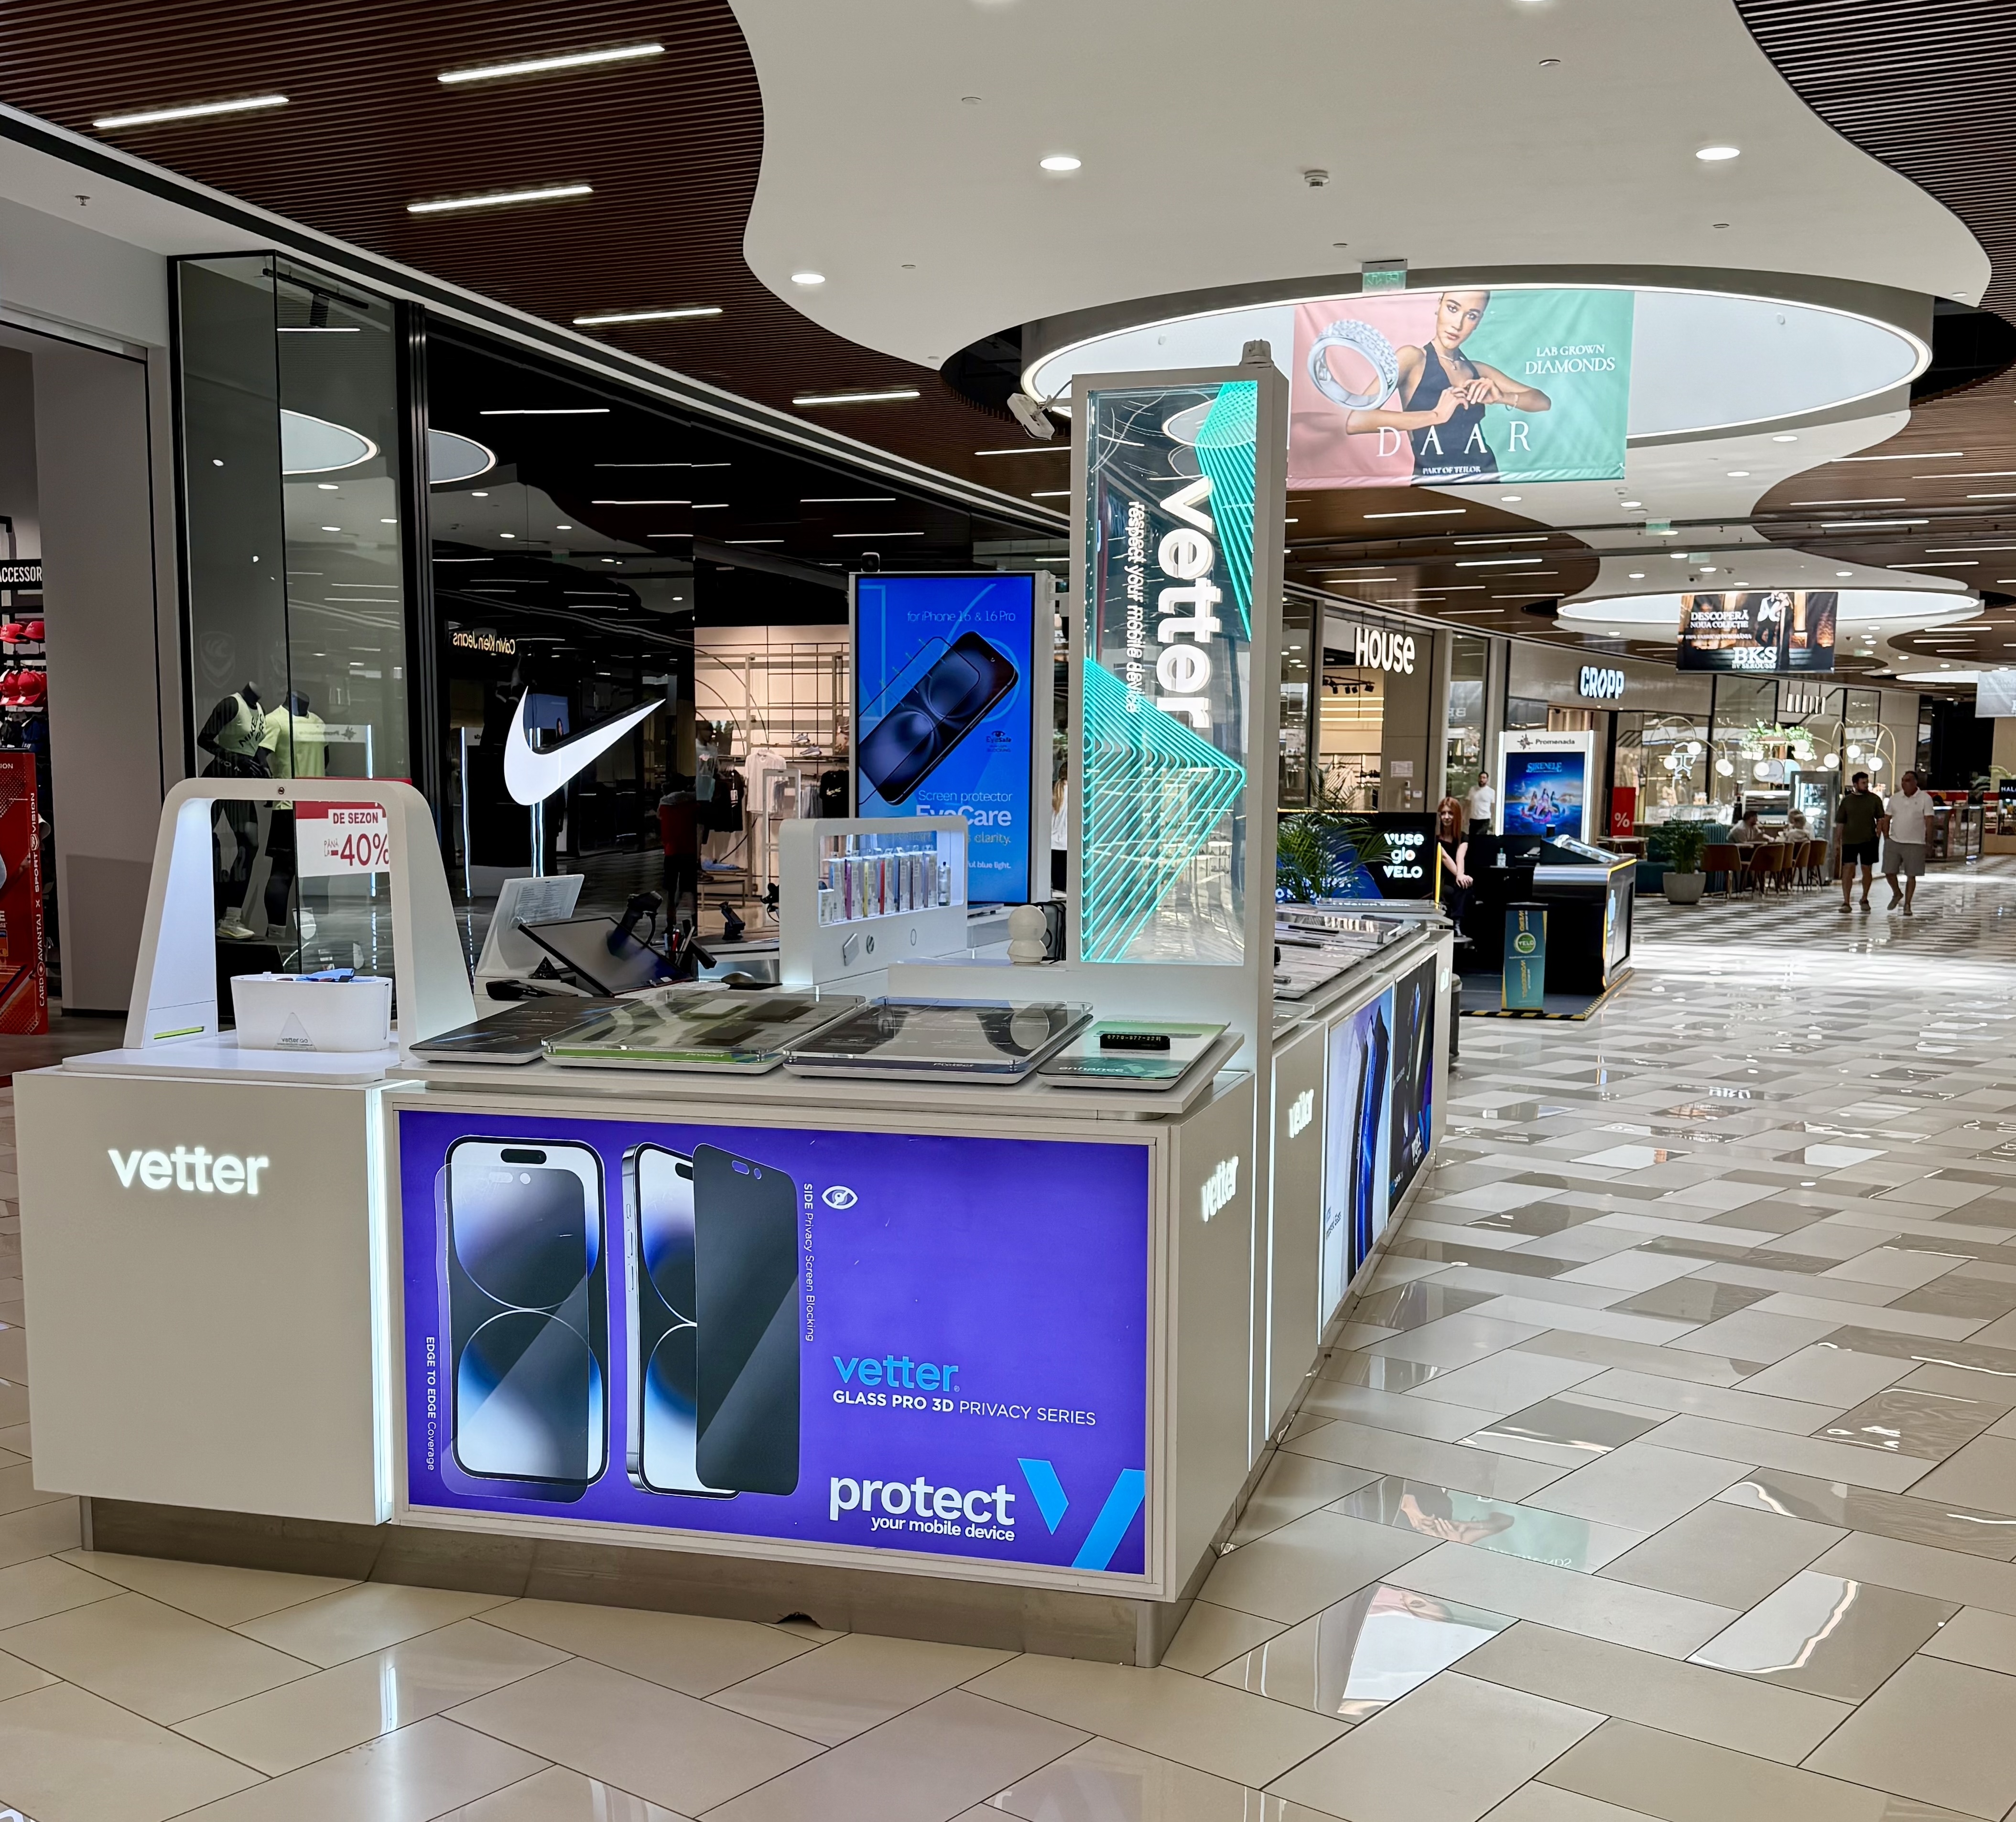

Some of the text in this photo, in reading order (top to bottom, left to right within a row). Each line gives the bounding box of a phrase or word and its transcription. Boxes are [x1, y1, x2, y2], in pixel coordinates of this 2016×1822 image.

[1525, 356, 1616, 375] DIAMONDS
[1536, 344, 1605, 357] LAB GROWN
[1377, 420, 1531, 457] DAAR
[908, 611, 1016, 621] for iPhone 16 & 16 Pro
[1124, 502, 1146, 712] respect your mobile device
[1157, 475, 1222, 728] vetter
[1691, 609, 1749, 621] DESCOPERĂ
[1732, 647, 1777, 664] BKS
[1580, 666, 1624, 699] CROPP
[238, 716, 258, 747] NIKE
[918, 790, 1013, 803] Screen protector
[333, 812, 379, 824] DE SEZON
[331, 833, 390, 866] -40%
[1391, 847, 1416, 864] glo
[1383, 865, 1423, 878] VELO
[108, 1145, 269, 1195] vetter
[1201, 1155, 1239, 1222] vetter
[804, 1183, 815, 1342] SIDE Privacy Screen Blocking
[833, 1355, 959, 1392] vetter
[426, 1337, 436, 1471] EDGE TO EDGE Coverage
[833, 1390, 1096, 1425] GLASS PRO 3D PRIVACY SERIES
[829, 1476, 1015, 1526] protect
[870, 1516, 1015, 1542] your mobile device
